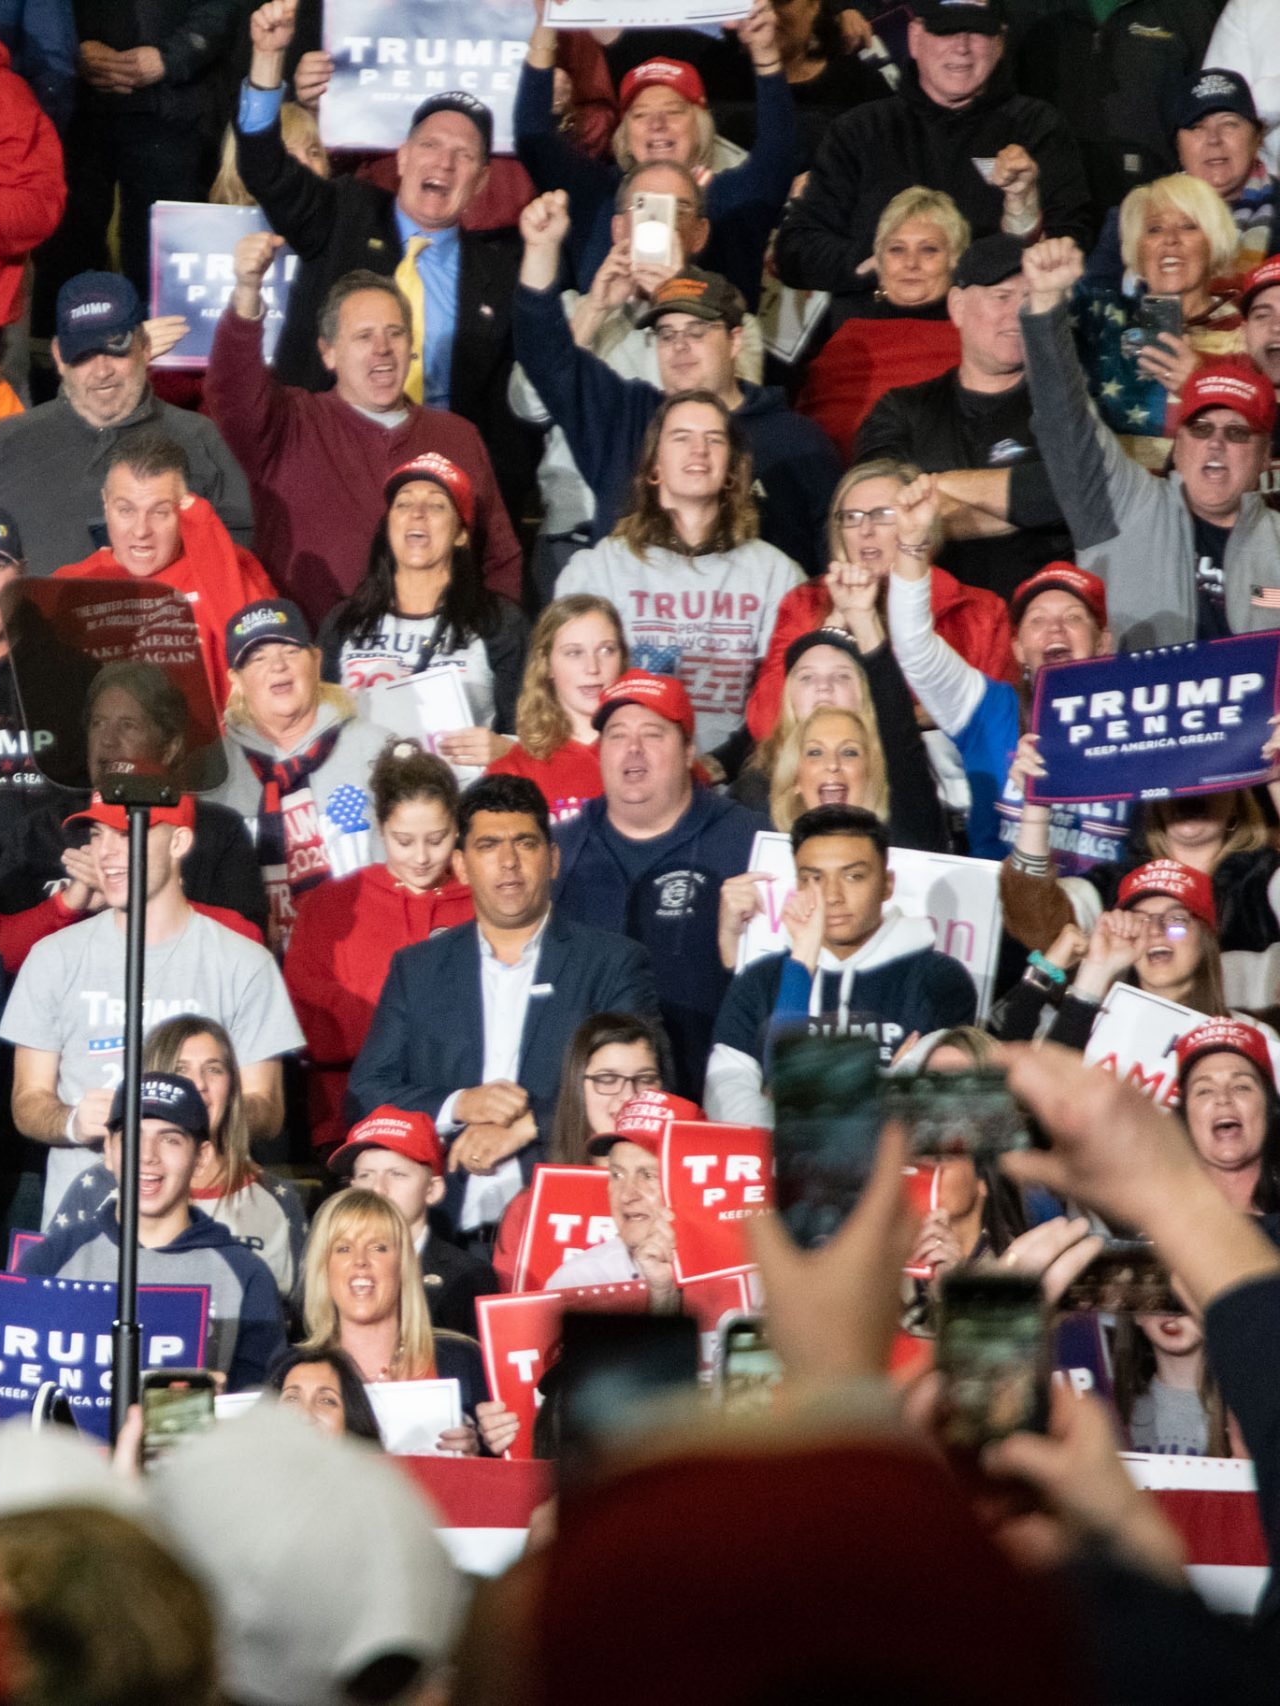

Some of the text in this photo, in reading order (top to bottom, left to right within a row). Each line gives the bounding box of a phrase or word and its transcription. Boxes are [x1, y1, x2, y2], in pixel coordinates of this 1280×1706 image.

[343, 37, 530, 66] TRUMP
[359, 68, 513, 91] PENCE
[70, 302, 111, 320] TRUMP
[629, 590, 760, 620] TRUMP
[241, 608, 276, 626] MAGA
[131, 633, 203, 651] AMERICA
[143, 650, 196, 663] AGAIN
[1052, 672, 1264, 723] TRUMP
[1069, 705, 1243, 745] PENCE
[1084, 731, 1225, 758] KEEP AMERICA GREAT!
[1140, 787, 1169, 800] 2020
[1131, 869, 1196, 889] AMERICA
[1188, 1026, 1252, 1044] AMERICA
[371, 1118, 413, 1131] AMERICA
[376, 1127, 407, 1139] AGAIN
